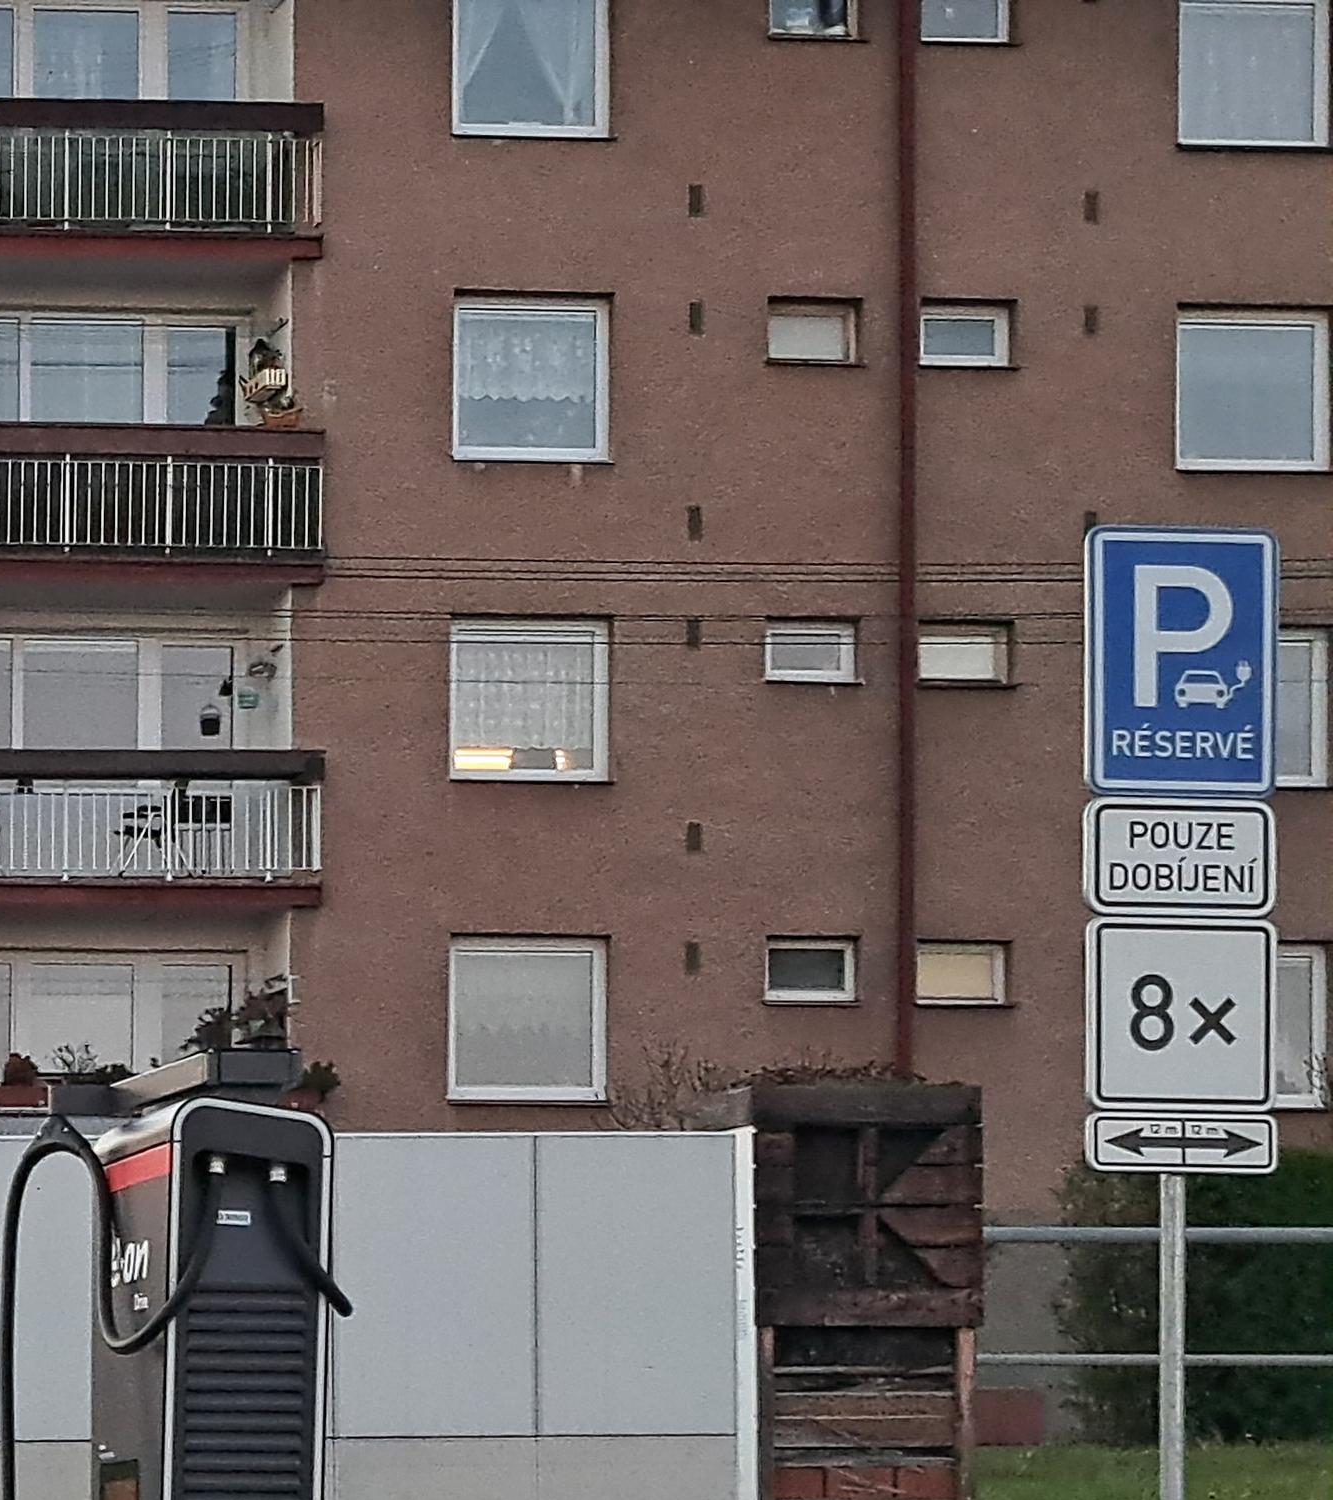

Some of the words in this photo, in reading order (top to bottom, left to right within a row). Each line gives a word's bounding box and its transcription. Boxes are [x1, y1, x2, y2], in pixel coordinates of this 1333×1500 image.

[1134, 565, 1234, 709] P
[1112, 723, 1255, 759] RÉSERVÉ
[1129, 820, 1235, 851] POUZE
[1109, 856, 1259, 894] DOBÍJENÍ
[1149, 1123, 1161, 1135] 12
[1165, 1126, 1178, 1135] m
[1190, 1124, 1202, 1136] 12
[1206, 1126, 1219, 1136] m
